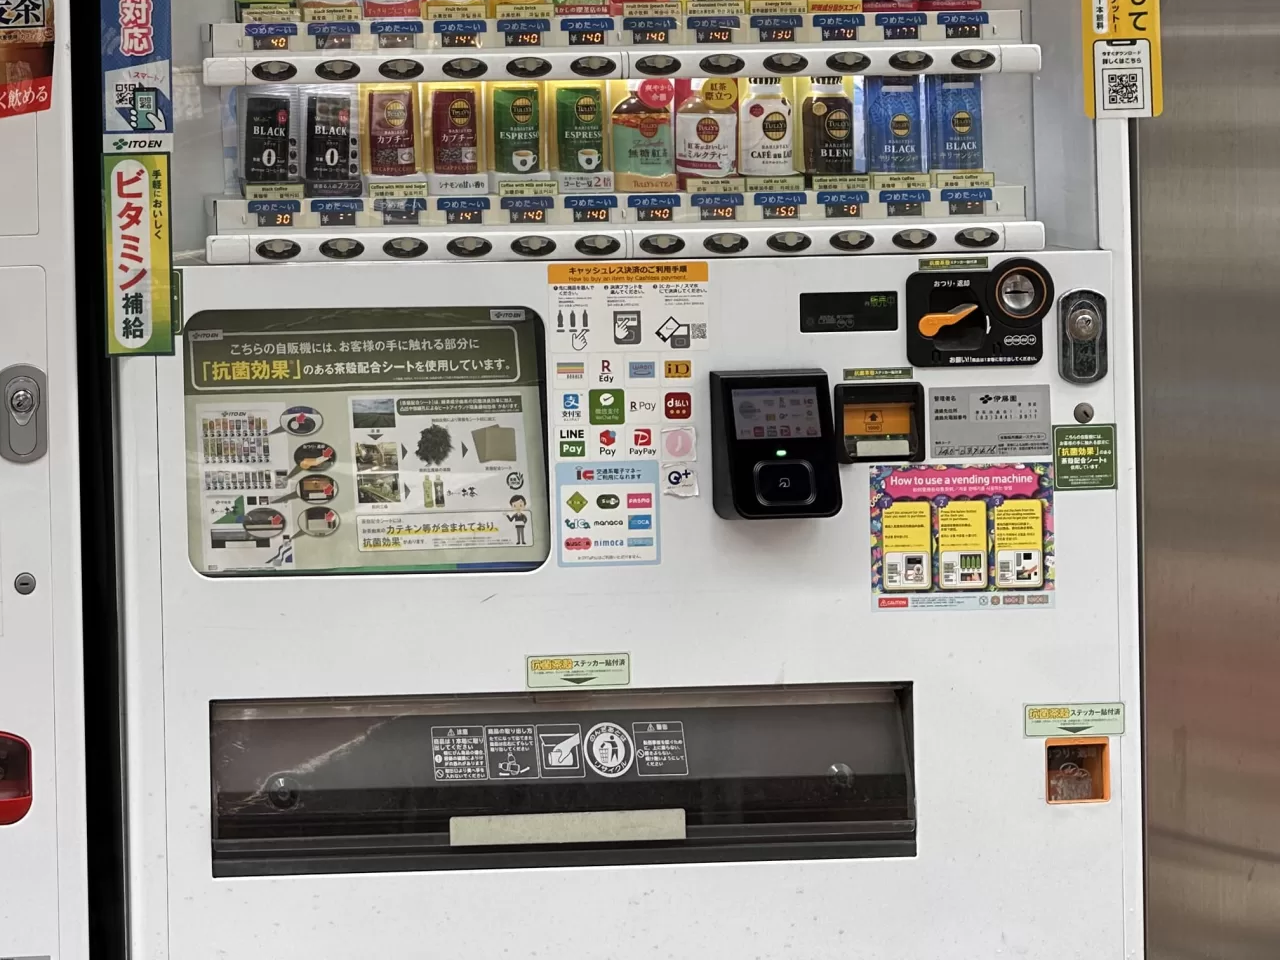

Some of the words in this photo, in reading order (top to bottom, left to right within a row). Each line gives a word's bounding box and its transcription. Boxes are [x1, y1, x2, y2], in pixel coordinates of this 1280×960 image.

[133, 71, 161, 81] スマート
[710, 82, 727, 91] 紅茶
[253, 125, 286, 137] BLACK
[127, 140, 147, 149] ITO
[147, 140, 162, 148] EN
[627, 148, 669, 159] 無糖紅茶
[686, 150, 729, 159] ミルクティー
[820, 148, 854, 158] BLEND
[152, 169, 163, 240] 手軽においしく
[116, 168, 148, 339] ビタミン補給
[568, 265, 688, 275] キャッシュレス決済のご利用手順
[933, 279, 971, 288] おつり・返却
[230, 337, 480, 356] こちらの自販機には、お客様の手に触れる部分に
[666, 363, 690, 375] iD
[598, 374, 614, 383] Edy
[666, 398, 689, 408] d払い
[993, 394, 1017, 403] 伊藤園
[559, 429, 585, 439] LINE
[562, 444, 583, 455] Pay
[599, 446, 616, 457] Pay
[629, 445, 657, 457] PayPay
[596, 467, 642, 475] 交通系電子マネー
[890, 475, 913, 486] How
[914, 476, 924, 486] to
[925, 476, 944, 486] use
[944, 477, 951, 486] a
[951, 475, 991, 489] vending
[992, 473, 1033, 484] machine
[593, 519, 624, 527] manaca
[593, 538, 624, 547] nimoca
